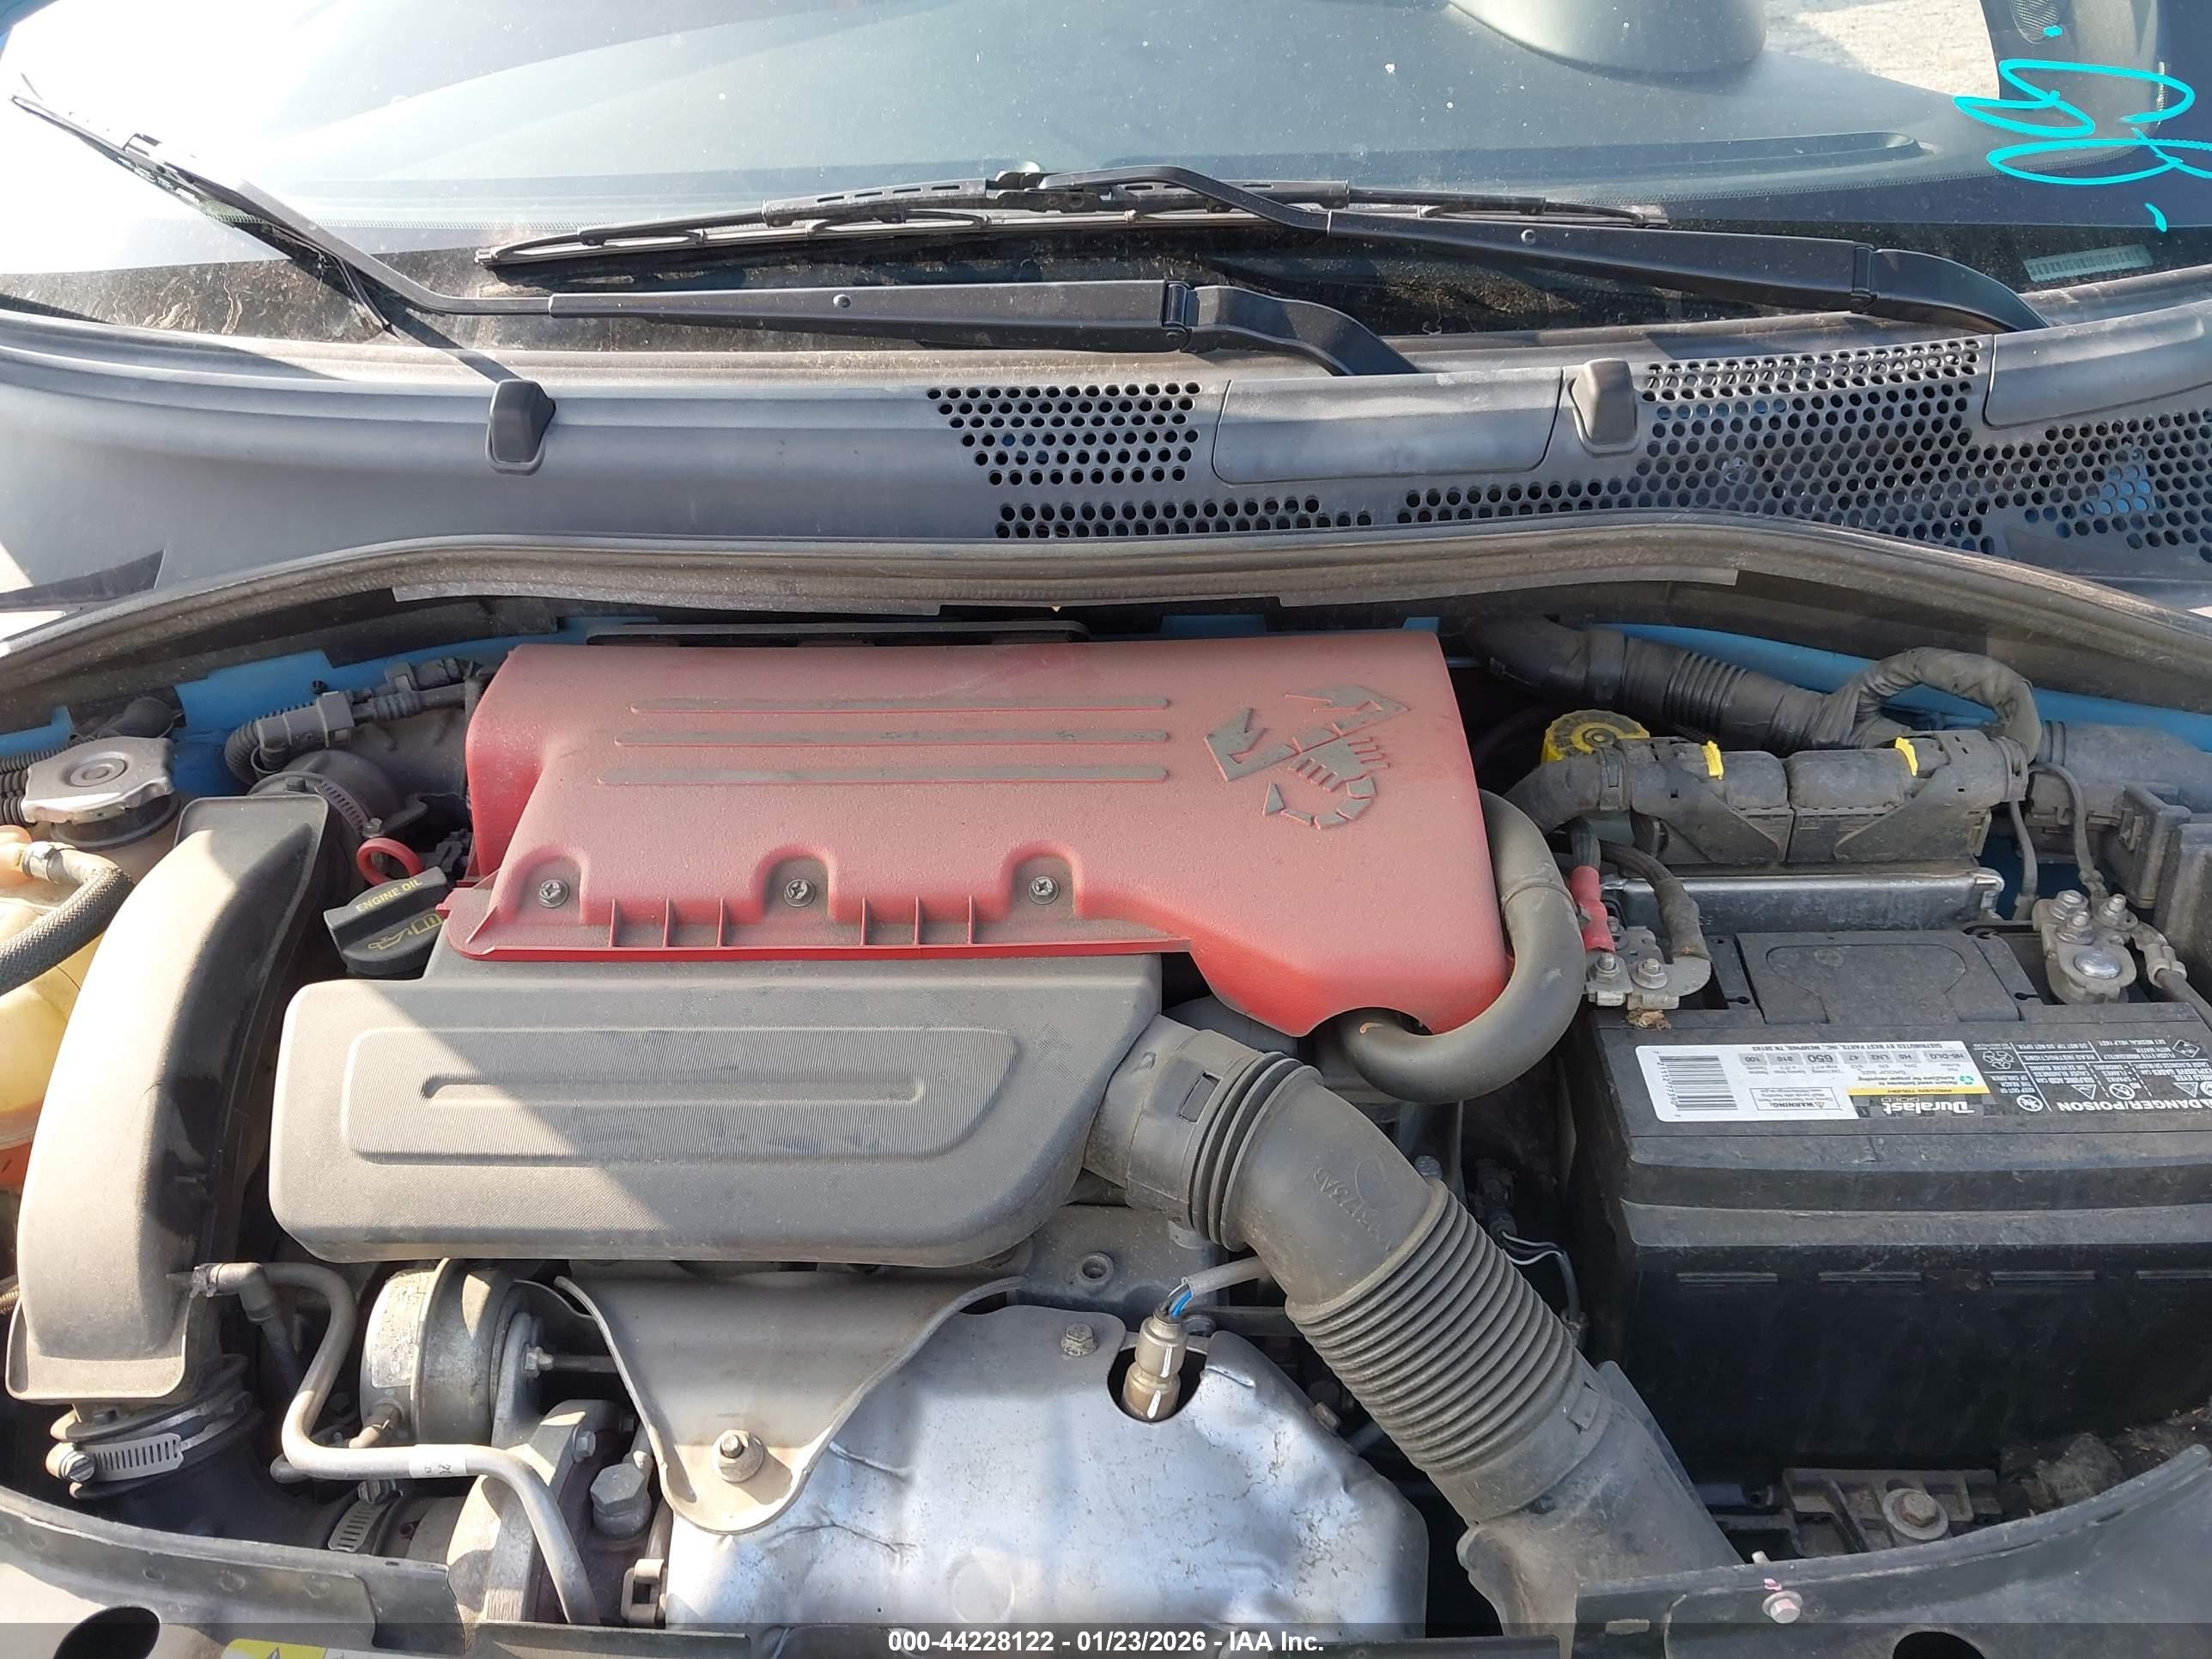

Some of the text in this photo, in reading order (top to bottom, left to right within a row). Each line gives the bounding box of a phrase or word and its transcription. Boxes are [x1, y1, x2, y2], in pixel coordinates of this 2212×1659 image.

[355, 878, 422, 913] ENGINE OIL
[1807, 1054, 1833, 1063] 650
[1657, 1062, 1669, 1082] 21112
[1881, 1101, 1975, 1115] Duralast
[2056, 1099, 2203, 1112] DANGER/POISON
